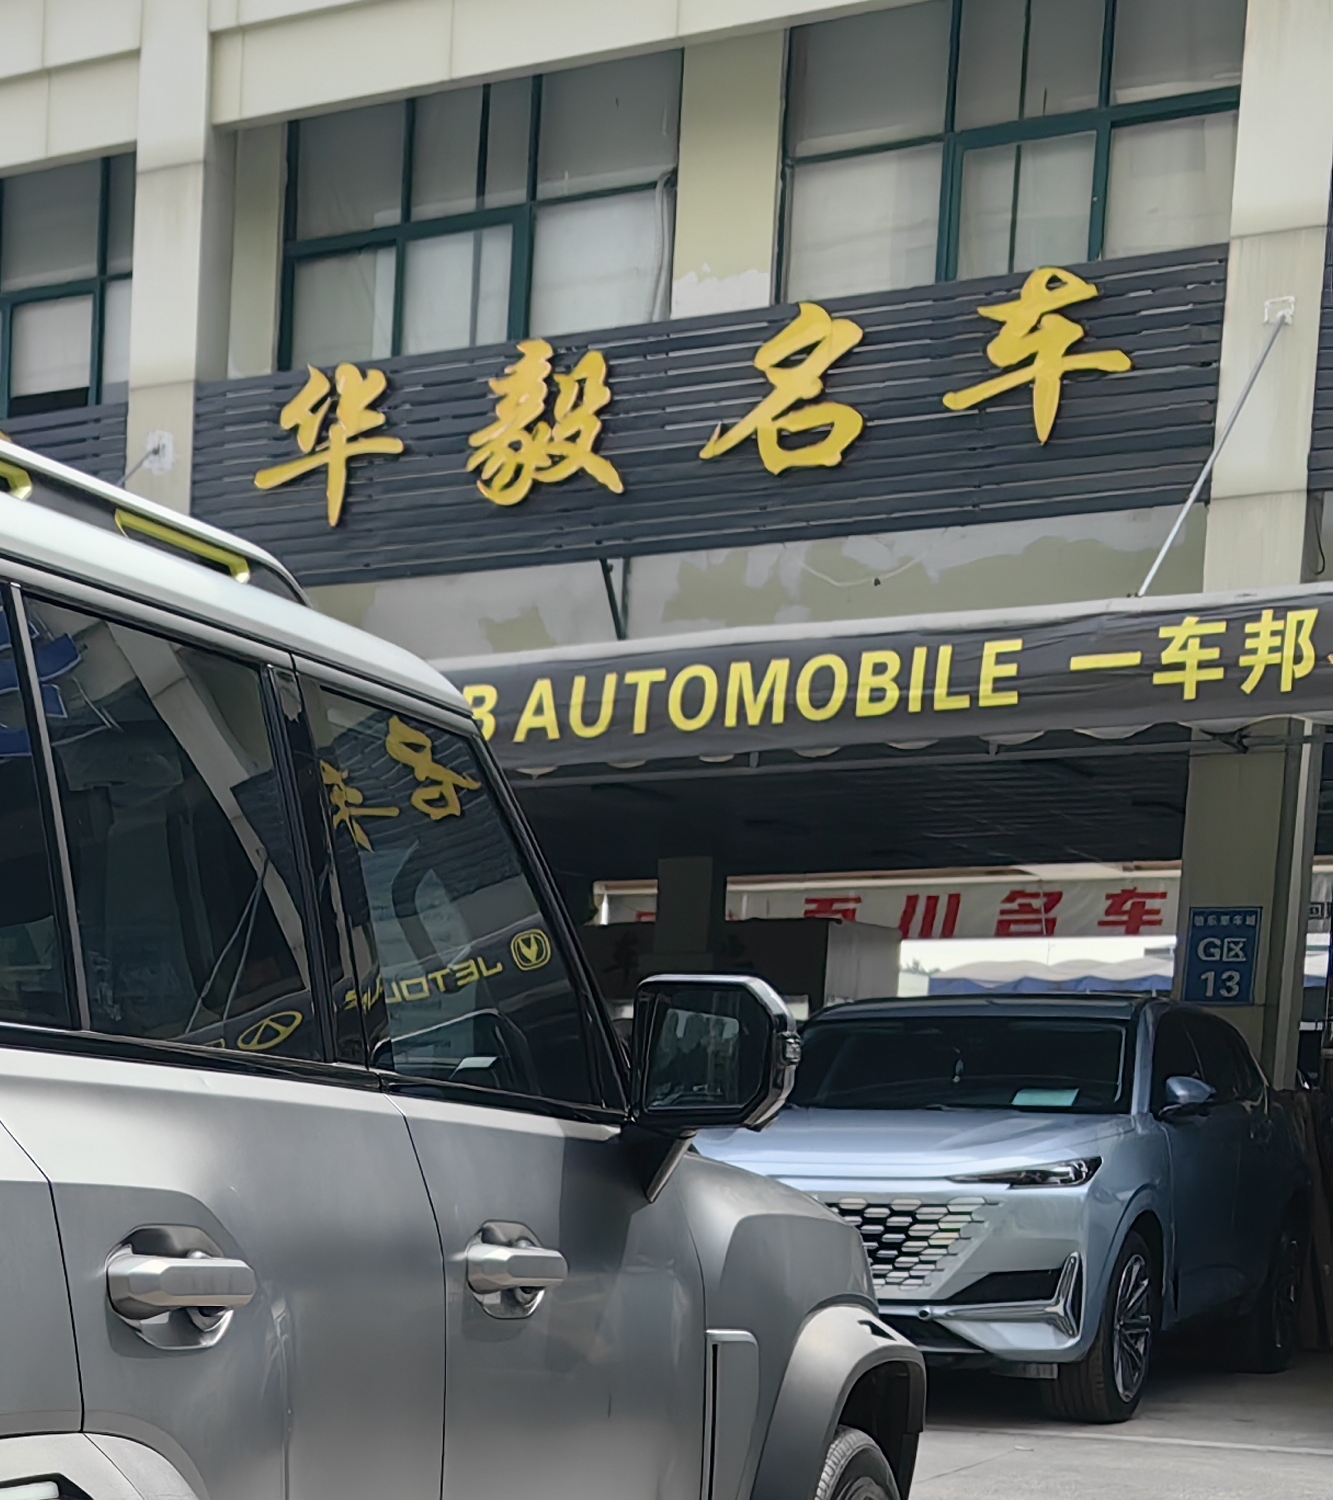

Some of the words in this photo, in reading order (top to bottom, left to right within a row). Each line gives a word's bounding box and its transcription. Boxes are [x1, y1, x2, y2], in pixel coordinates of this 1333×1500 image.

[253, 266, 1133, 528] 华毅名车
[512, 638, 1024, 743] AUTOMOBILE
[1069, 608, 1319, 701] 一车邦
[1196, 937, 1247, 962] G区
[1199, 970, 1241, 998] 13
